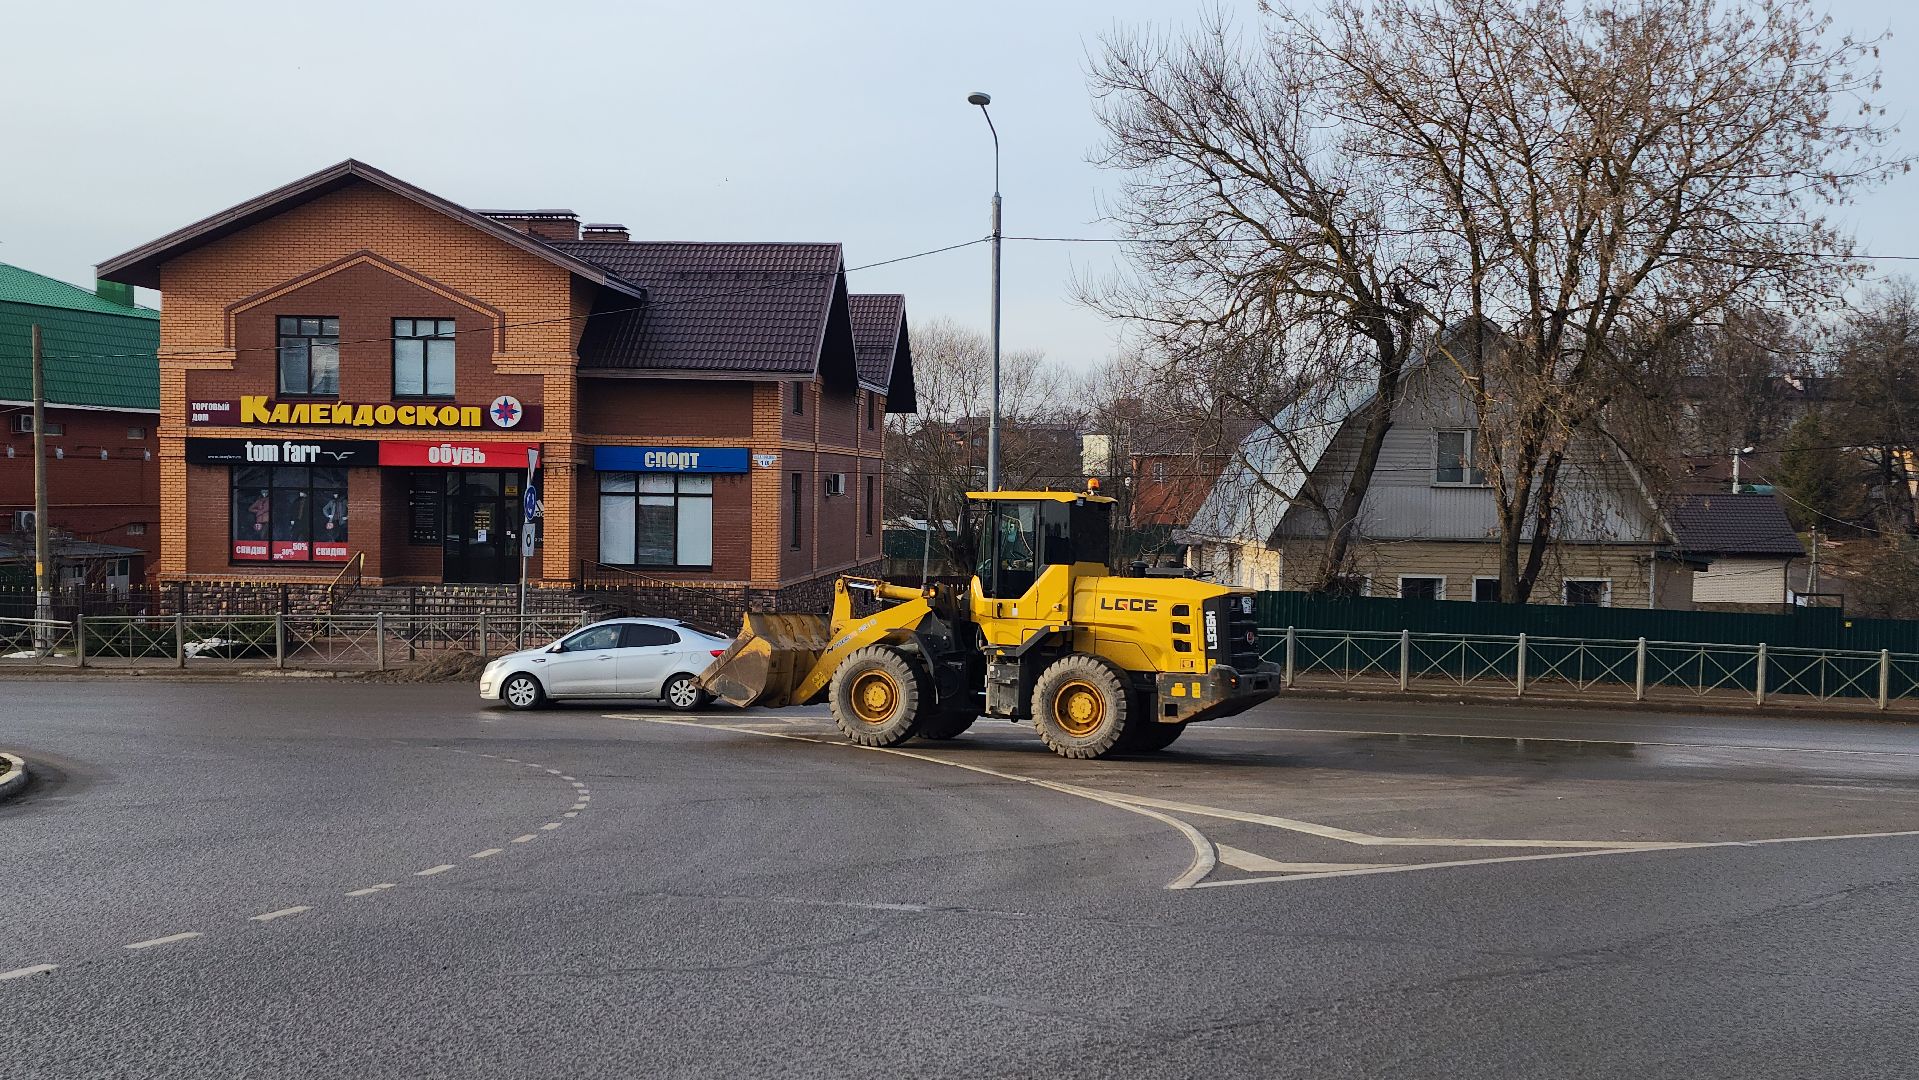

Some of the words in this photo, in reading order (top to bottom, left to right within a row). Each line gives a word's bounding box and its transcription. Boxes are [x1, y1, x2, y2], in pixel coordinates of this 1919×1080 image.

[191, 402, 230, 411] ТОРГОВЫЙ
[192, 413, 209, 422] ДОМ
[240, 395, 481, 427] КАЛЕЙДОСКОП
[245, 441, 279, 462] tom
[283, 441, 320, 463] farr
[428, 443, 486, 466] обувь
[292, 542, 308, 551] 50%
[1205, 610, 1218, 650] L936H
